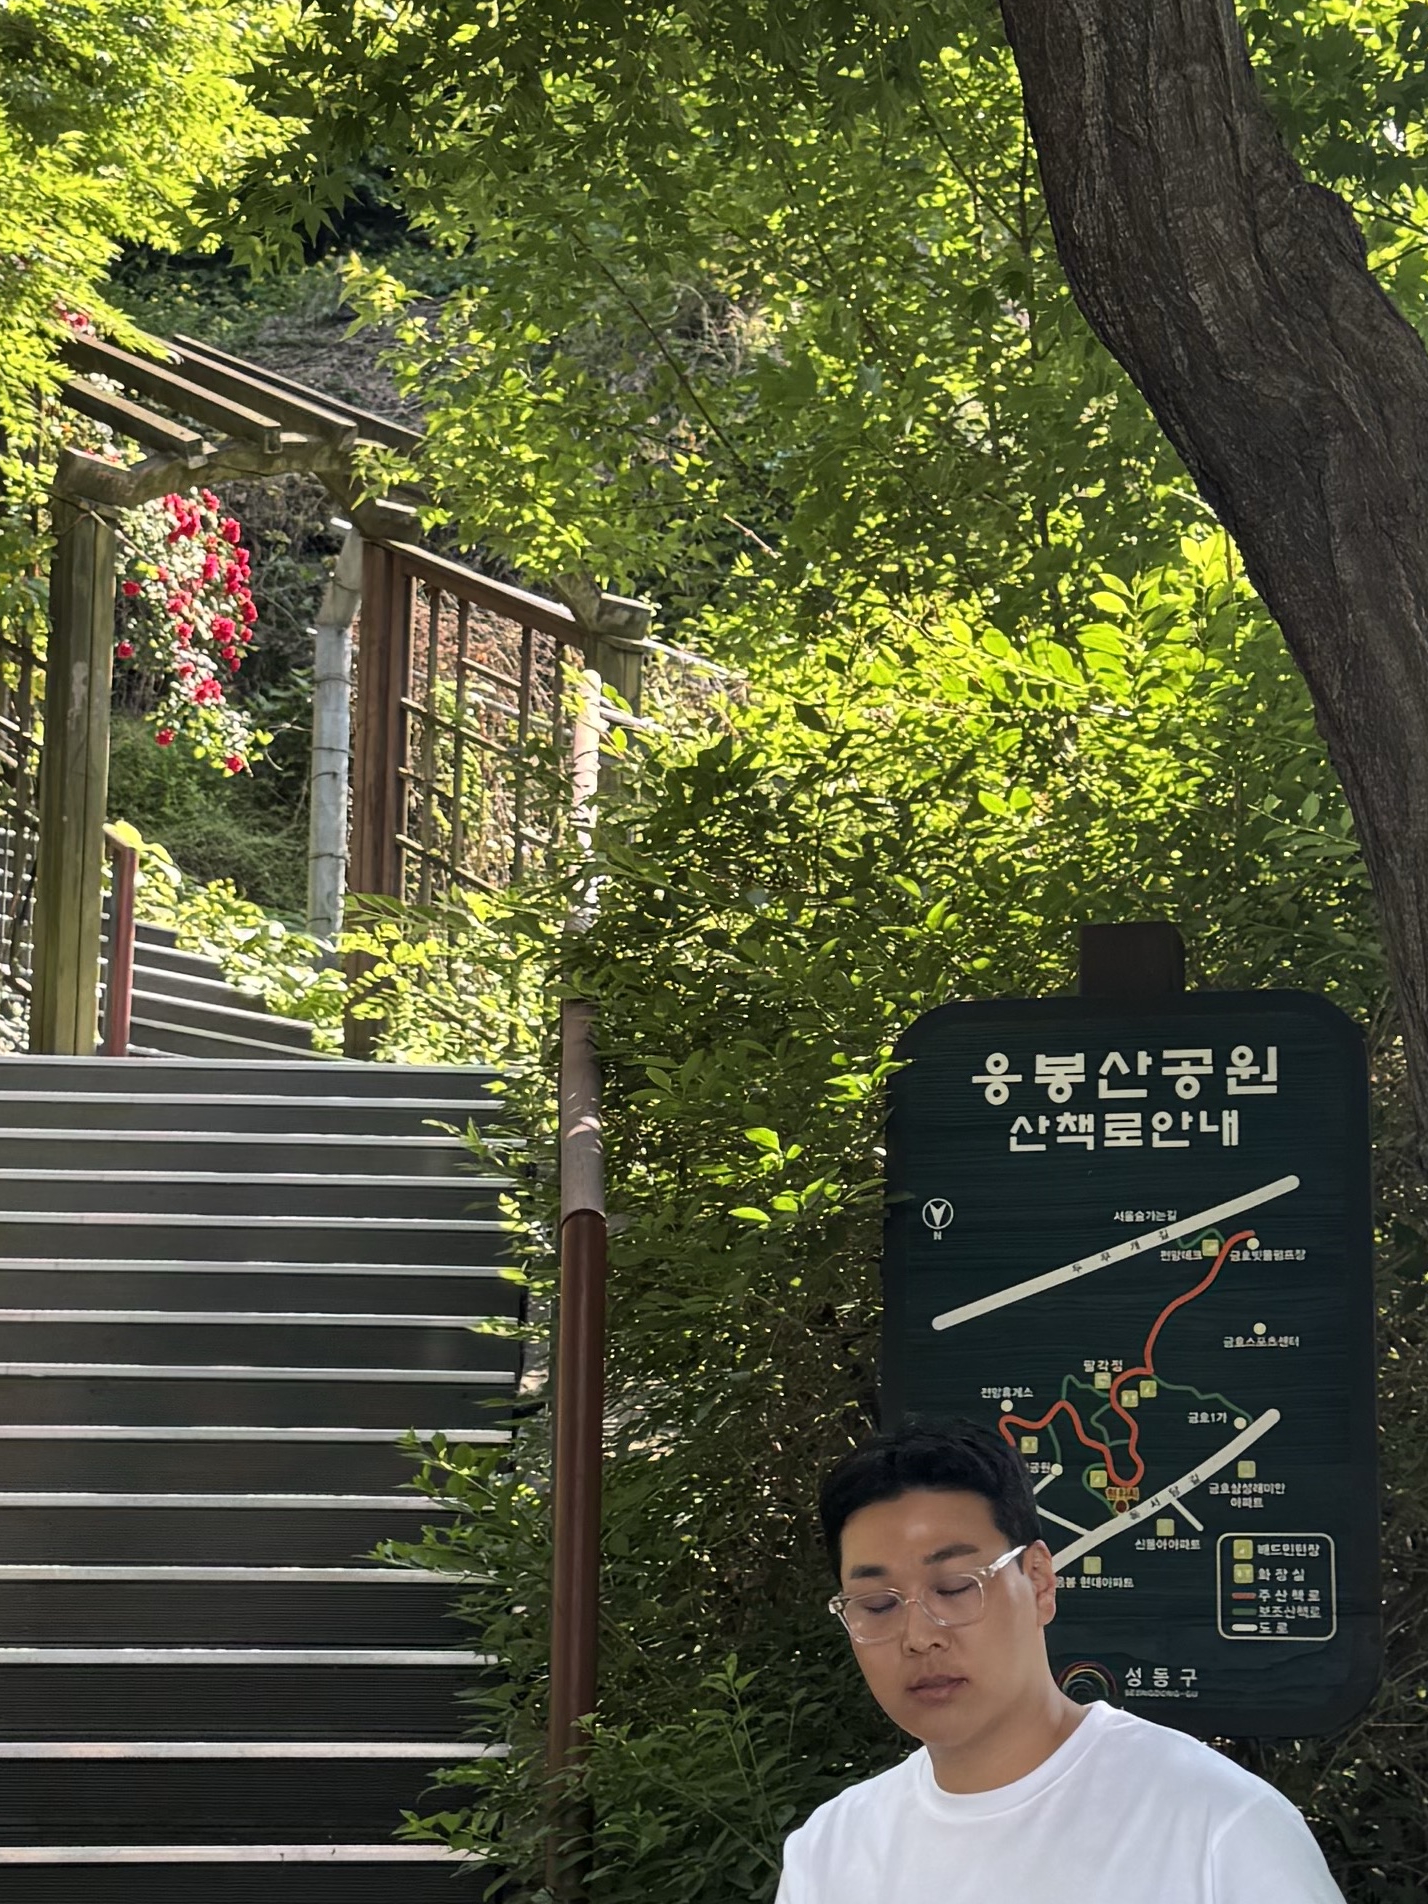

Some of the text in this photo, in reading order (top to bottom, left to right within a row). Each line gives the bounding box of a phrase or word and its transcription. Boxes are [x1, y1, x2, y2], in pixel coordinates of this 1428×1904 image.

[972, 1045, 1278, 1105] 응봉산공원
[1009, 1110, 1239, 1152] 산책로안내
[1113, 1210, 1177, 1222] 서울숲가는길
[933, 1231, 942, 1240] N
[1223, 1336, 1300, 1348] 금호스포츠센터
[1083, 1359, 1123, 1373] 팔각정
[1230, 1497, 1264, 1508] 아파트
[1257, 1543, 1320, 1557] 배드민턴장
